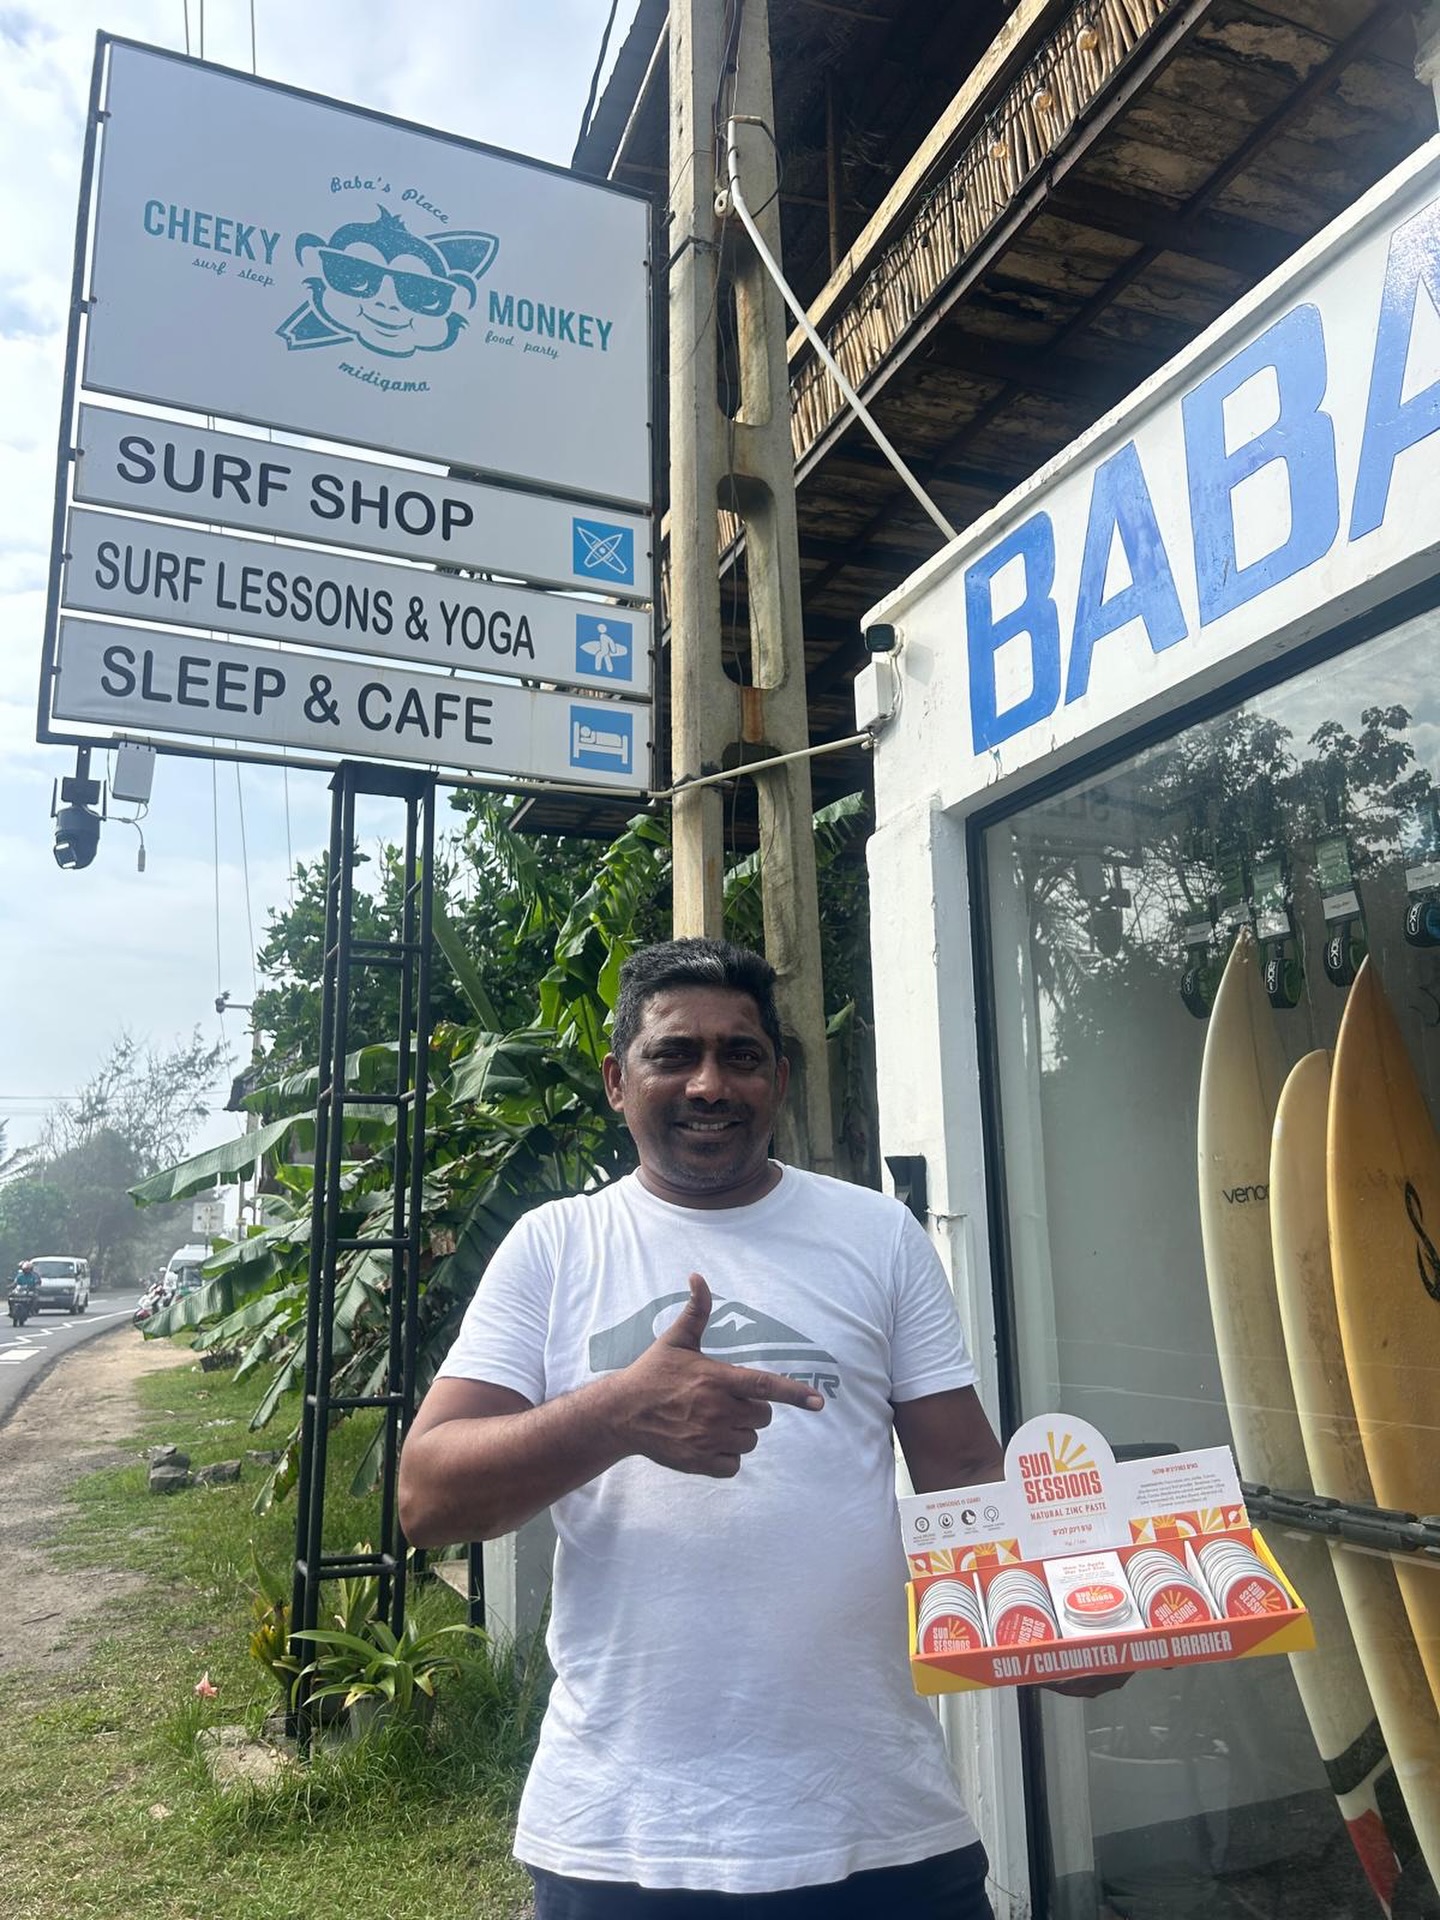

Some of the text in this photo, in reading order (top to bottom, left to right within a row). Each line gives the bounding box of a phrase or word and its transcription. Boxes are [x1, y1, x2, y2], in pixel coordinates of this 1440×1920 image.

[330, 175, 449, 224] Baba's Place
[143, 200, 281, 265] CHEEKY
[192, 258, 275, 287] surf sleep
[488, 290, 613, 352] MONKEY
[485, 330, 559, 359] food party
[338, 362, 431, 392] midigama
[116, 434, 474, 542] SURF SHOP
[95, 540, 535, 660] SURF LESSONS & YOGA
[101, 645, 494, 747] SLEEP & CAFE
[1222, 1185, 1269, 1204] veno
[1018, 1451, 1053, 1479] SUN
[1023, 1470, 1103, 1505] SESSIONS
[1030, 1502, 1107, 1521] NATURAL ZINC PASTE
[1248, 1581, 1266, 1599] SUN
[1154, 1602, 1171, 1622] SUN
[933, 1627, 949, 1640] SUN
[992, 1630, 1233, 1679] SUN / COLDWATER / WIND BARRIER
